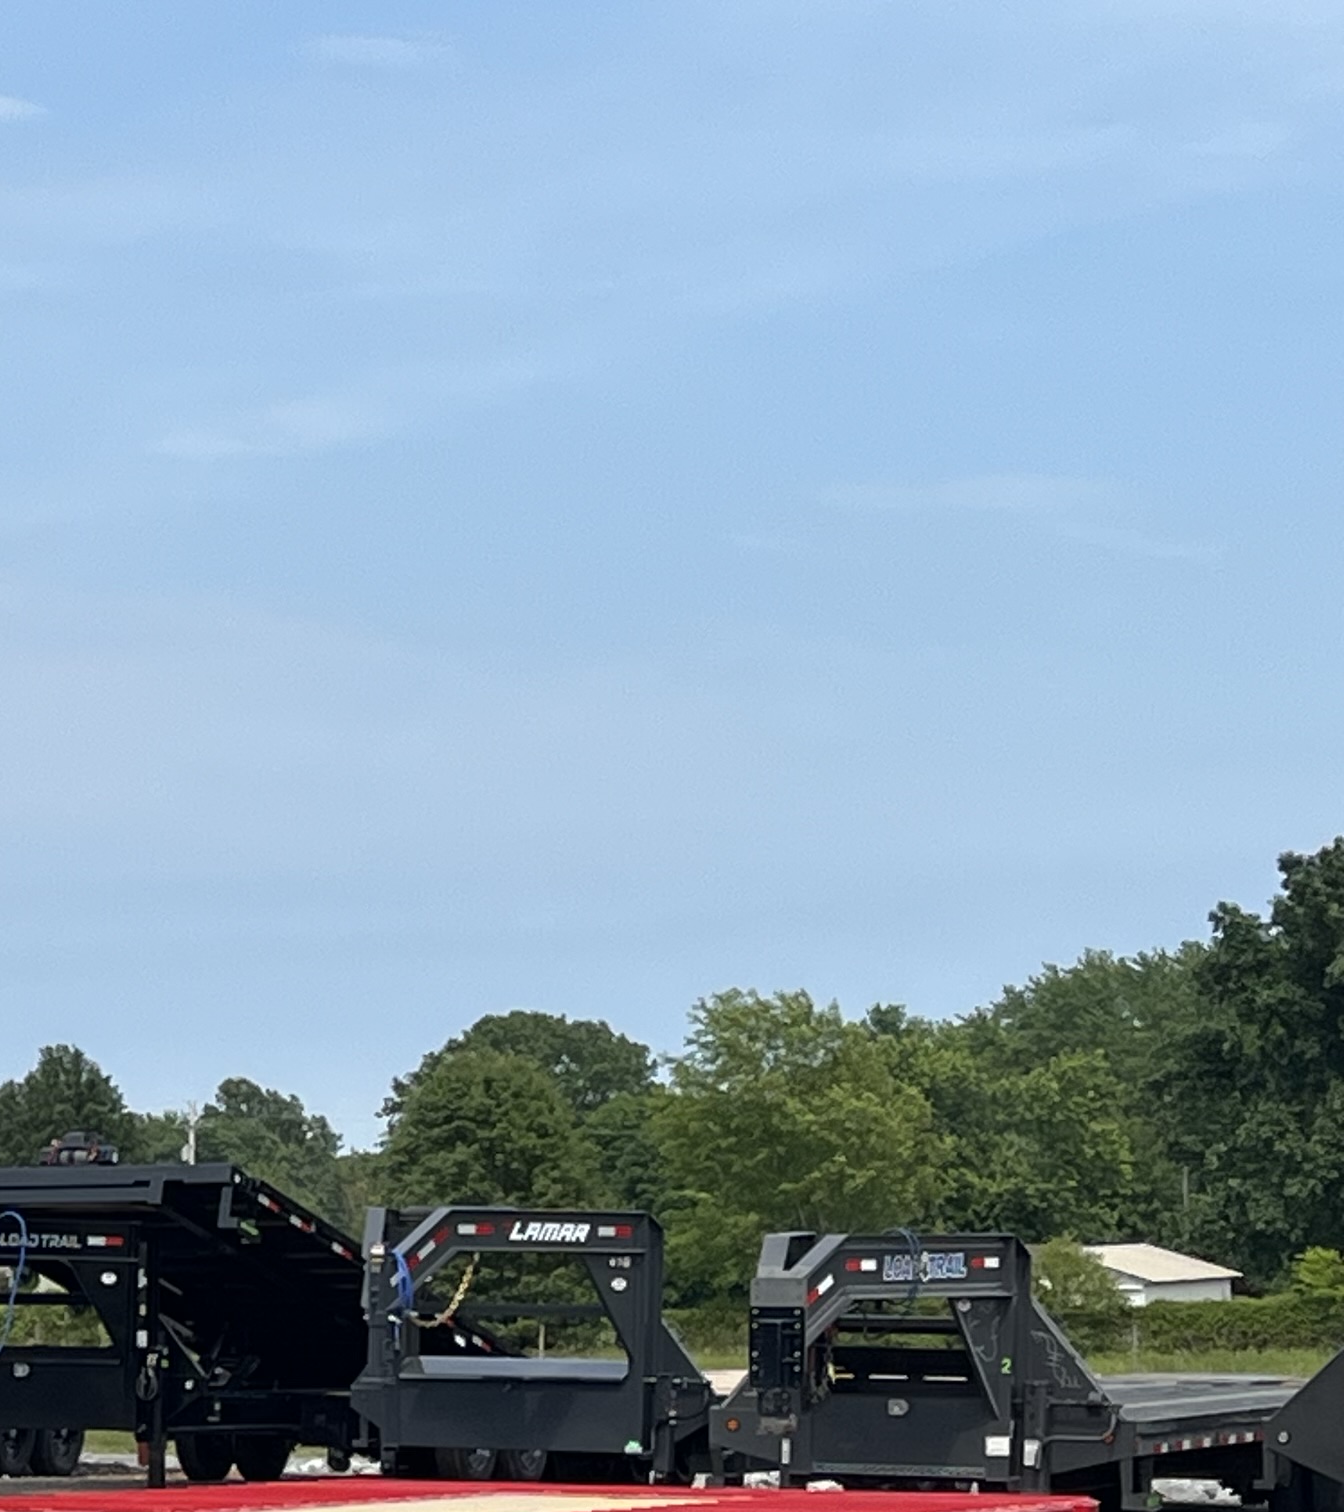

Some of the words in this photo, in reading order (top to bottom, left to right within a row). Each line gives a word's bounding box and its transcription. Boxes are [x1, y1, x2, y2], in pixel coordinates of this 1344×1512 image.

[40, 1233, 82, 1249] TRAIL
[508, 1220, 591, 1242] LAMAR
[883, 1254, 921, 1281] LOA
